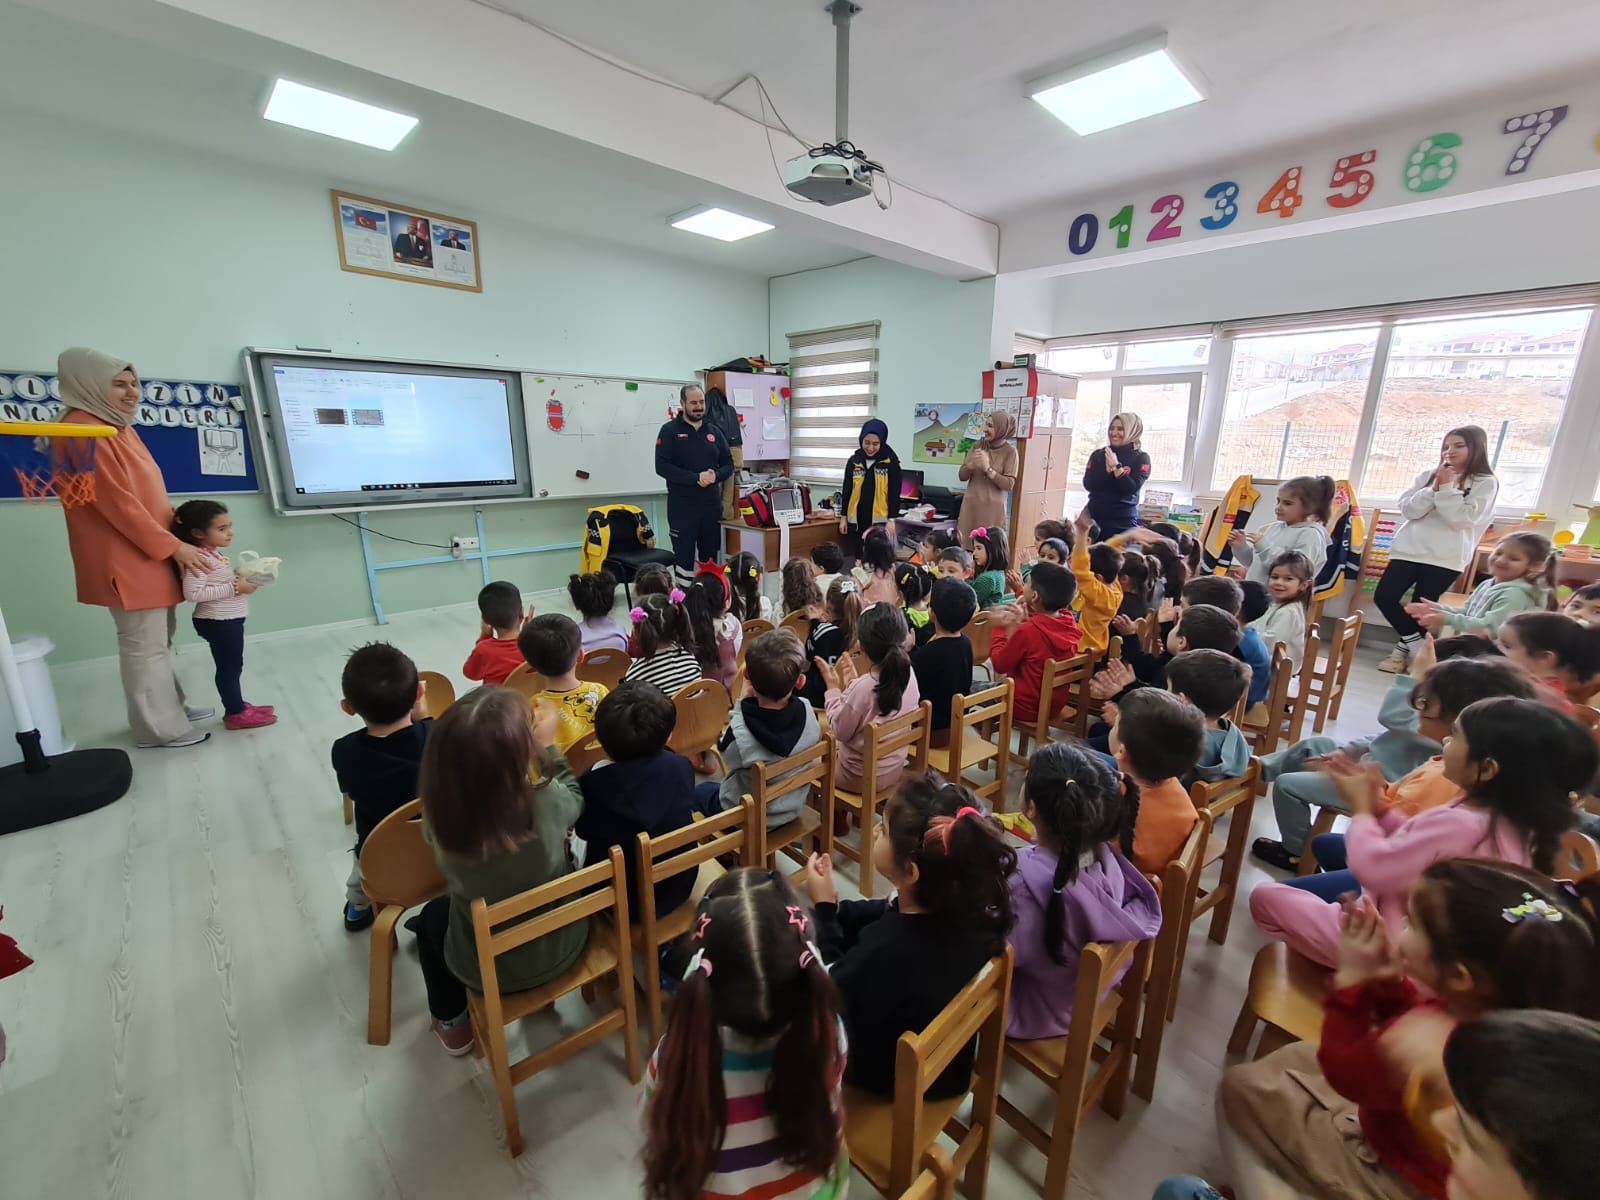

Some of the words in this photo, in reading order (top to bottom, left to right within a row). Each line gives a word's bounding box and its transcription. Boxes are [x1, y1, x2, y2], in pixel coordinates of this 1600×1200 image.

[1069, 213, 1098, 255] 0
[1109, 204, 1134, 248] 1
[1147, 195, 1184, 242] 2
[1200, 182, 1239, 231] 3
[1257, 167, 1303, 219] 4
[1327, 150, 1377, 209] 5
[1405, 132, 1462, 194] 6
[1503, 105, 1569, 175] 7
